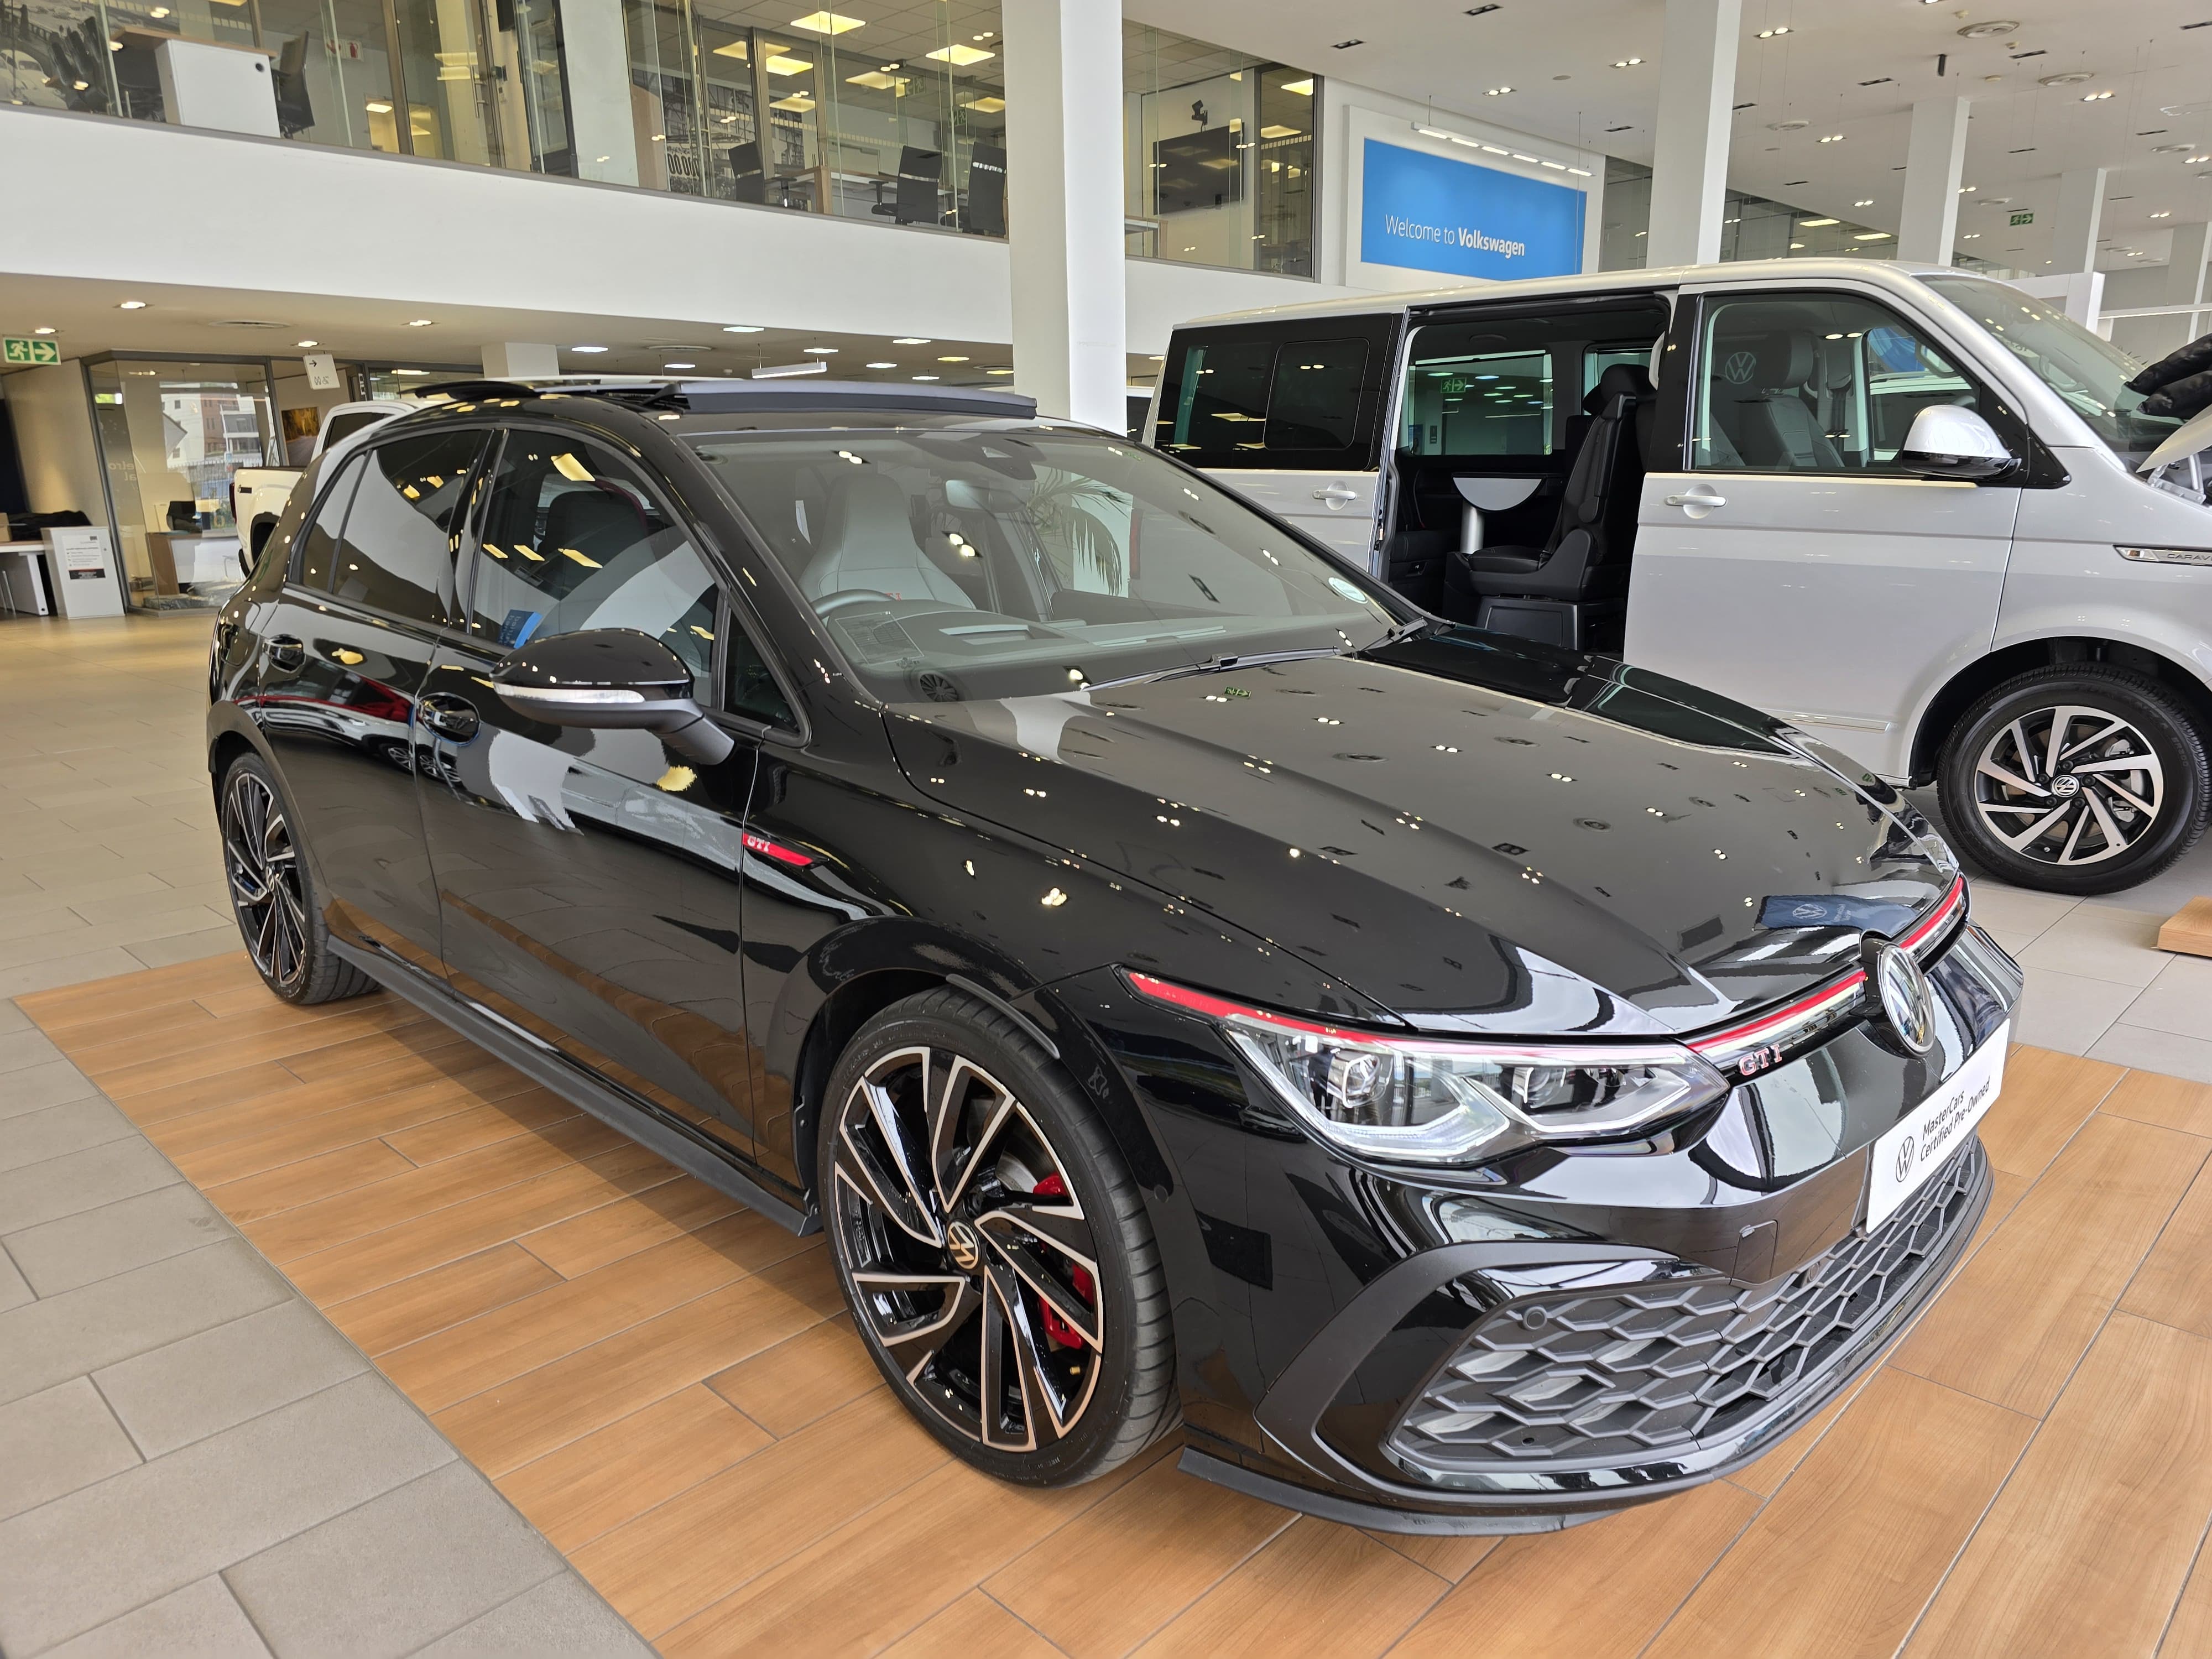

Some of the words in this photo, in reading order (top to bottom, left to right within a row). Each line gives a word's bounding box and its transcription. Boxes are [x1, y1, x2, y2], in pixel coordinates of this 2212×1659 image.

[1385, 214, 1441, 243] Welcome
[1444, 227, 1455, 244] to
[1458, 227, 1525, 258] Volkswagen
[747, 835, 770, 852] GTI
[1739, 1044, 1782, 1076] GTI
[1921, 1116, 1954, 1162] Certified
[1954, 1075, 1990, 1129] Pre-Owned
[1922, 1090, 1965, 1141] MasterCars
